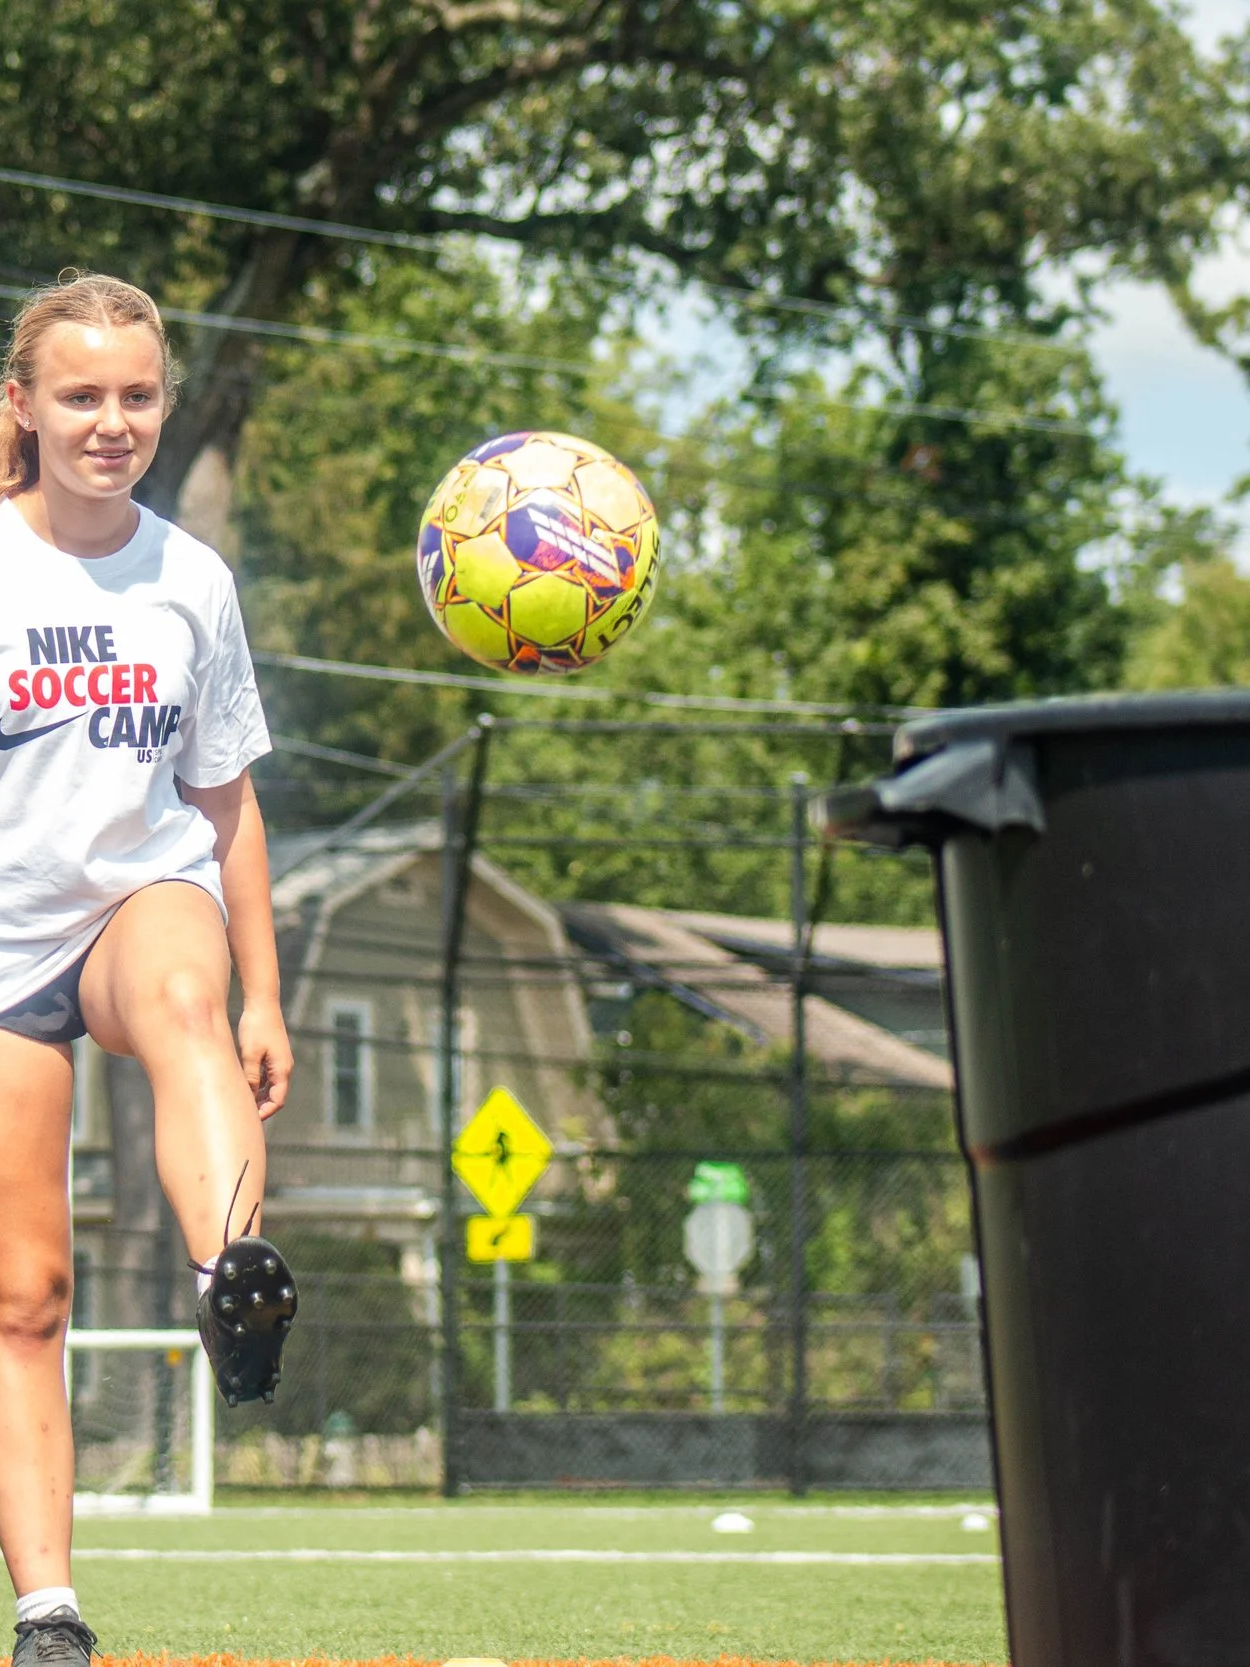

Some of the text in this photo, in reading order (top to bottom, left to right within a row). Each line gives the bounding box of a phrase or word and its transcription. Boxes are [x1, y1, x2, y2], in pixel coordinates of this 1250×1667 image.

[26, 625, 118, 666] NIKE
[8, 663, 159, 711] SOCCER
[88, 705, 182, 749] CAMP
[137, 749, 153, 763] US
